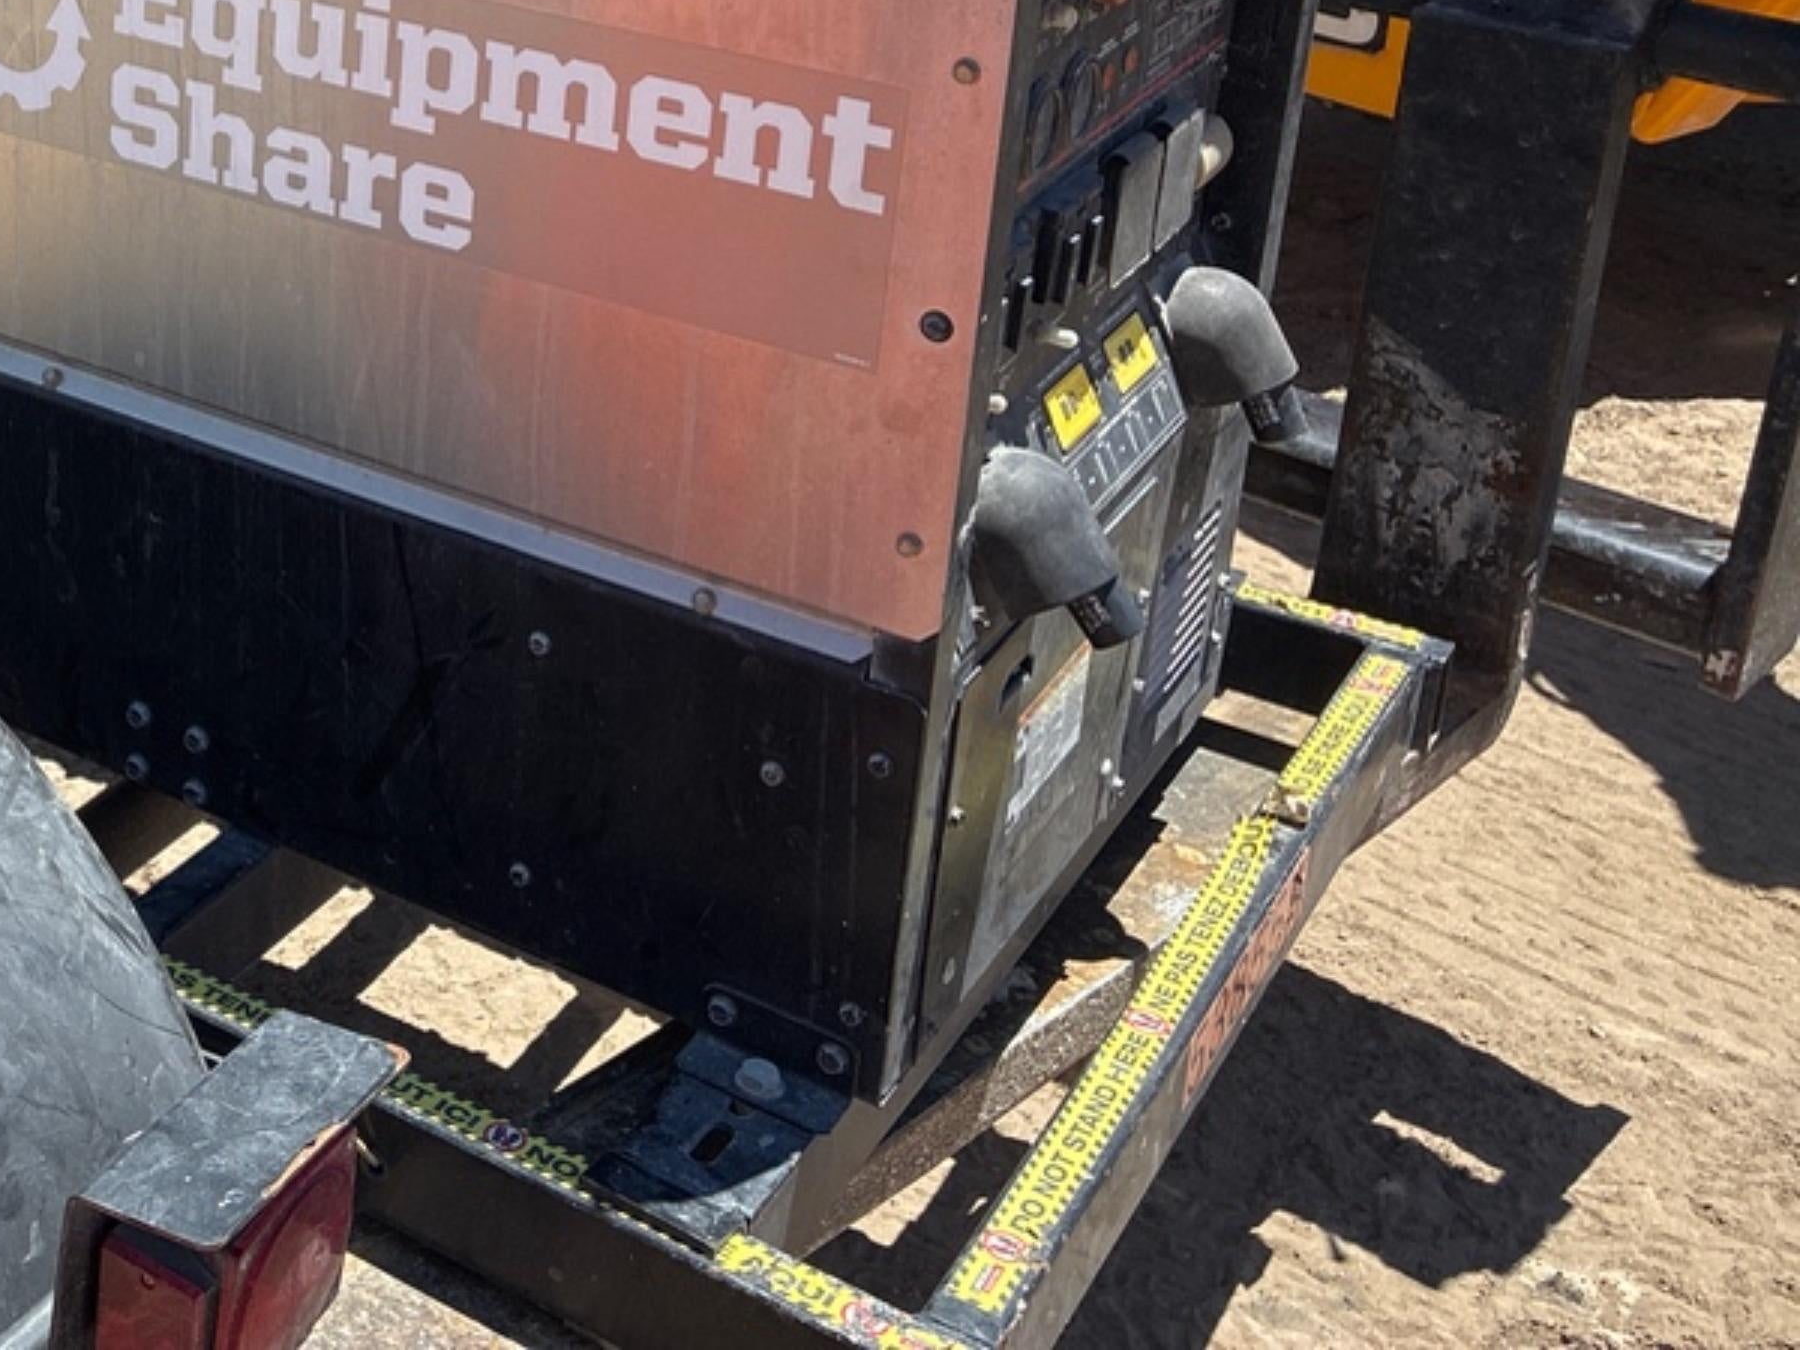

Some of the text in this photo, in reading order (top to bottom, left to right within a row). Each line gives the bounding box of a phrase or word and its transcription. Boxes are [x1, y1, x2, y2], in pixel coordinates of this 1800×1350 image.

[109, 62, 476, 252] Share
[1185, 895, 1231, 948] TENEZ
[1163, 948, 1199, 985] PAS
[1149, 981, 1180, 1011] NE
[1031, 1150, 1075, 1204] NOT
[1062, 1082, 1118, 1154] STAND
[1110, 1031, 1151, 1084] HERE
